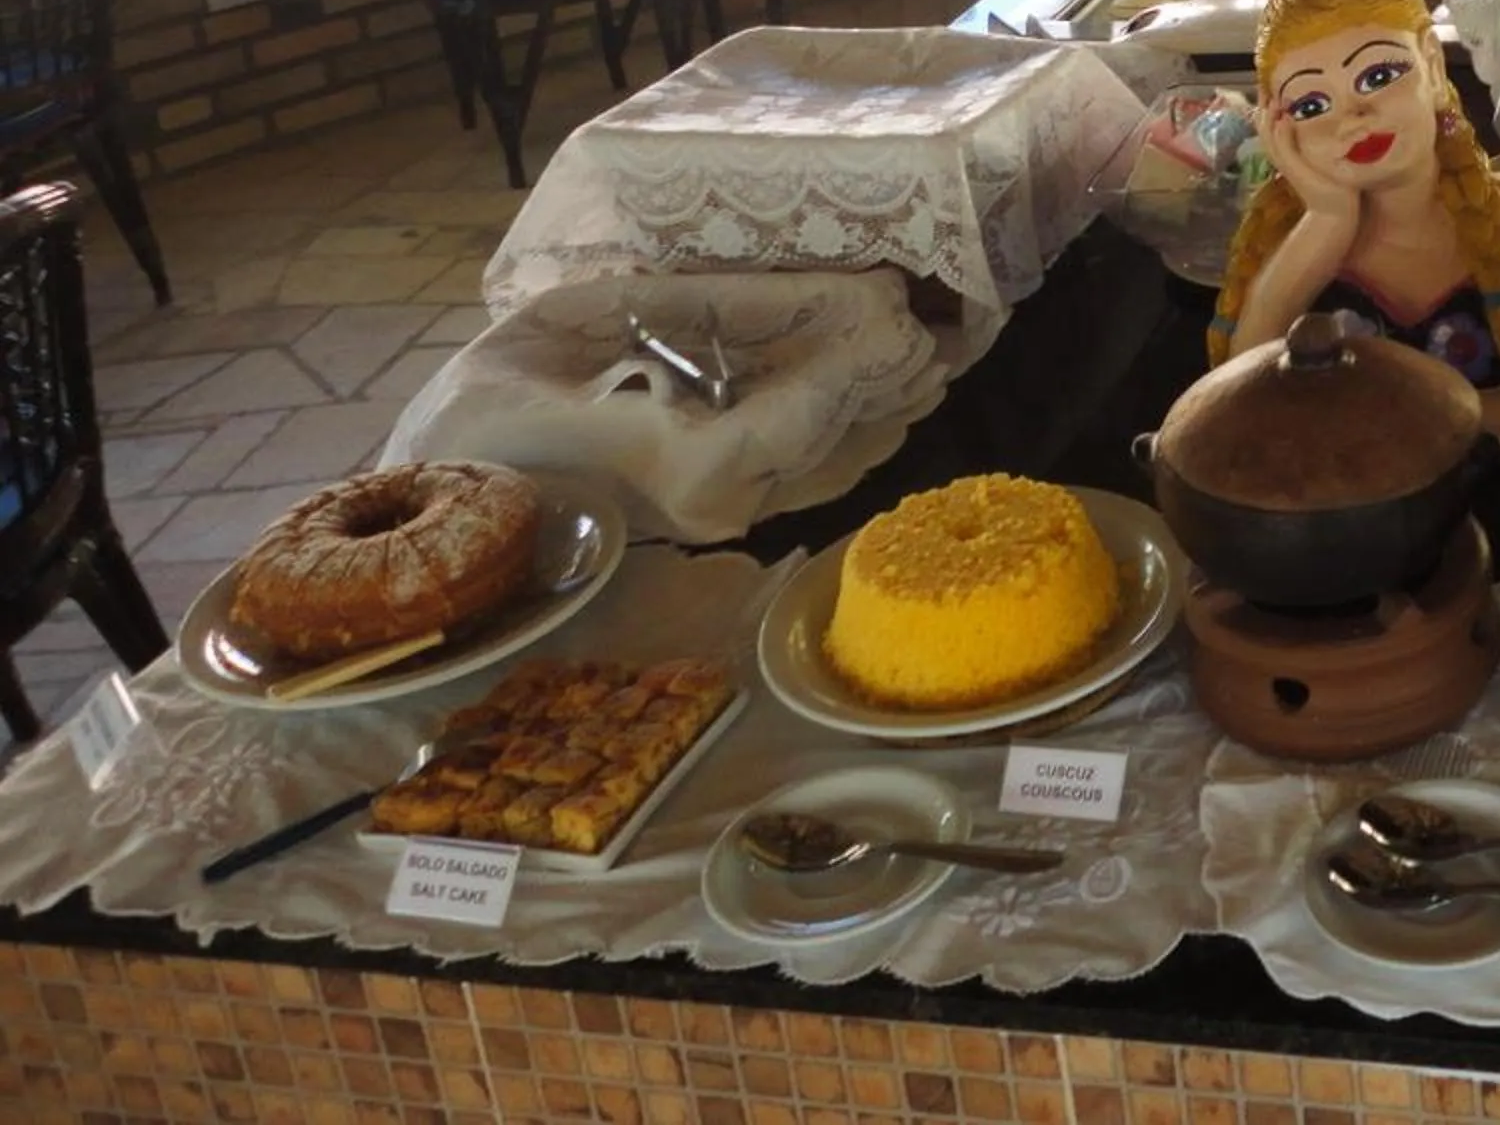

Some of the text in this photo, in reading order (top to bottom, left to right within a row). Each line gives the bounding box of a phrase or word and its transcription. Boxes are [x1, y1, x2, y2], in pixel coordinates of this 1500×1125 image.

[1035, 763, 1095, 781] CUSCUZ
[1020, 783, 1103, 803] COUSCOUS
[407, 854, 508, 881] BOLO SALGADO
[410, 882, 489, 906] SALT CAKE
